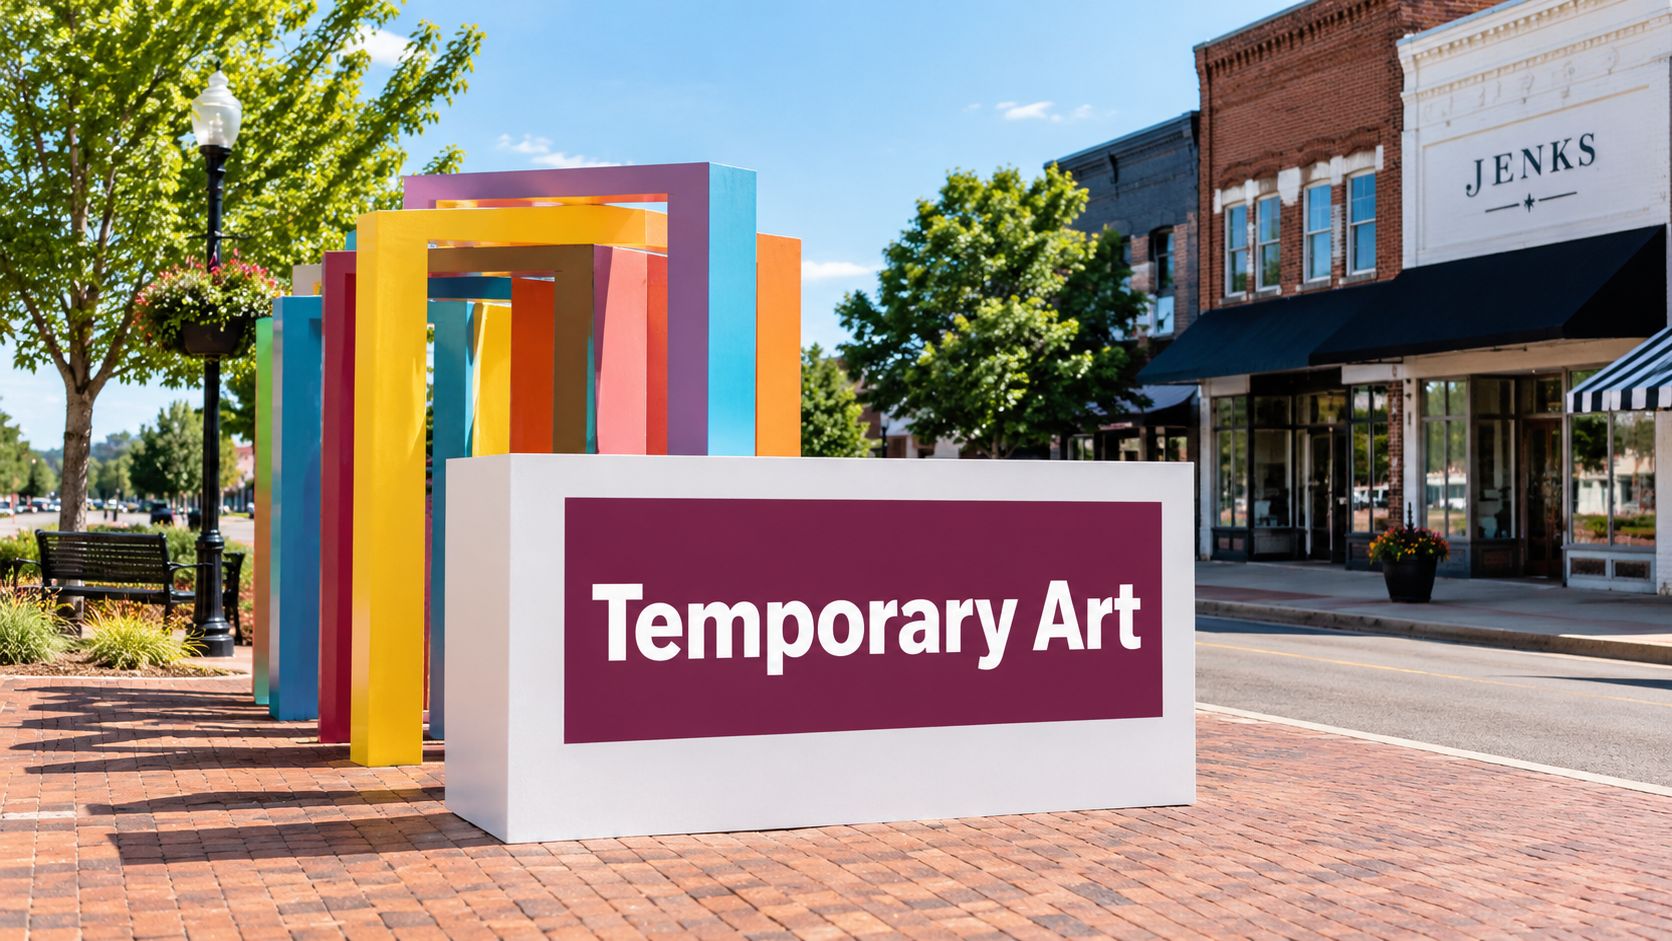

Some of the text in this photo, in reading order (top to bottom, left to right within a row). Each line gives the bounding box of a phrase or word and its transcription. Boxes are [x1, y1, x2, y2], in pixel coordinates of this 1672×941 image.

[1465, 132, 1596, 198] JENKS
[591, 580, 1142, 676] Temporary Art
